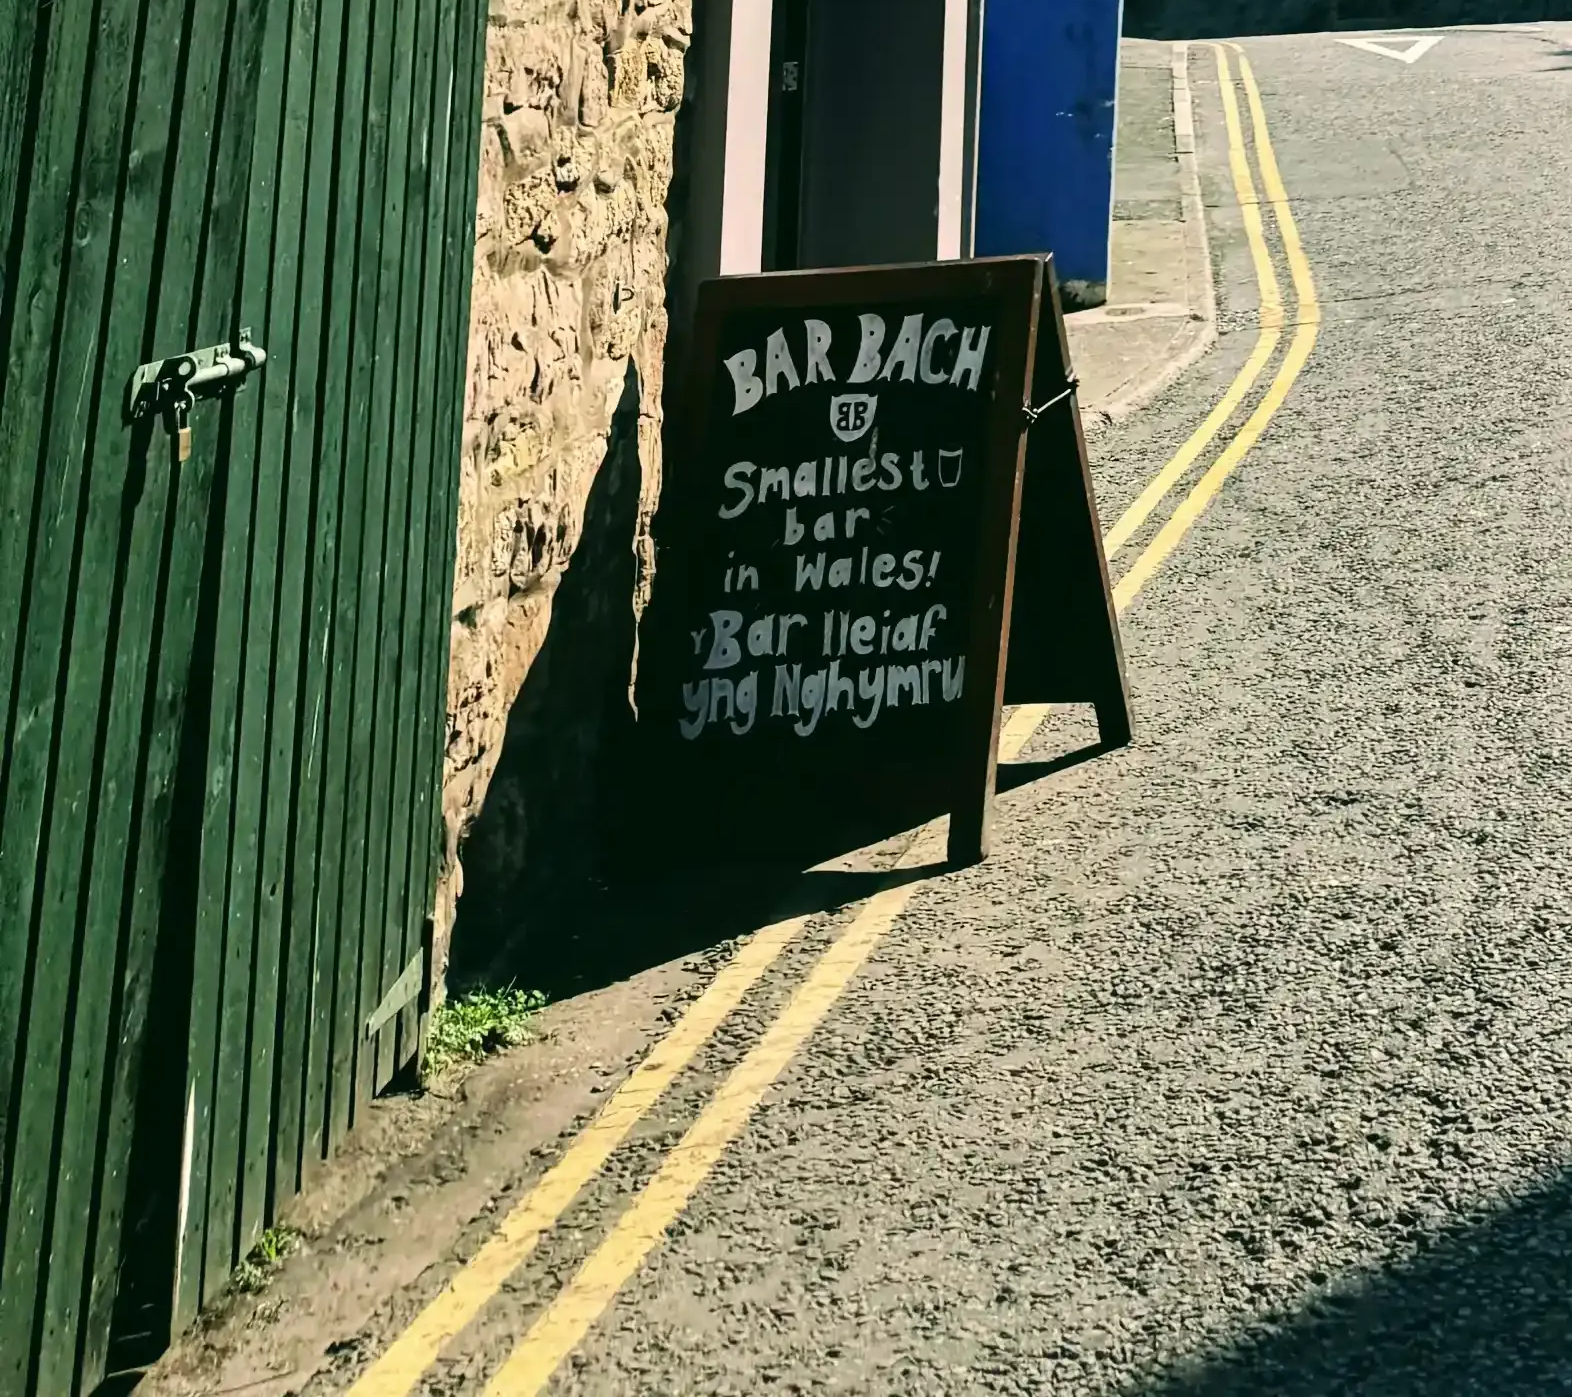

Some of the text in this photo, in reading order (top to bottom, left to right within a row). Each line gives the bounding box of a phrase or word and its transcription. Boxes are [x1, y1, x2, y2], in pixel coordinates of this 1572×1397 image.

[723, 312, 992, 417] BAR BACH
[718, 450, 930, 520] Smallest
[783, 506, 871, 546] bar
[723, 546, 942, 593] in Wales!
[702, 609, 809, 670] Bar
[822, 603, 948, 657] lleiaf
[678, 655, 967, 741] yng Nghymru
